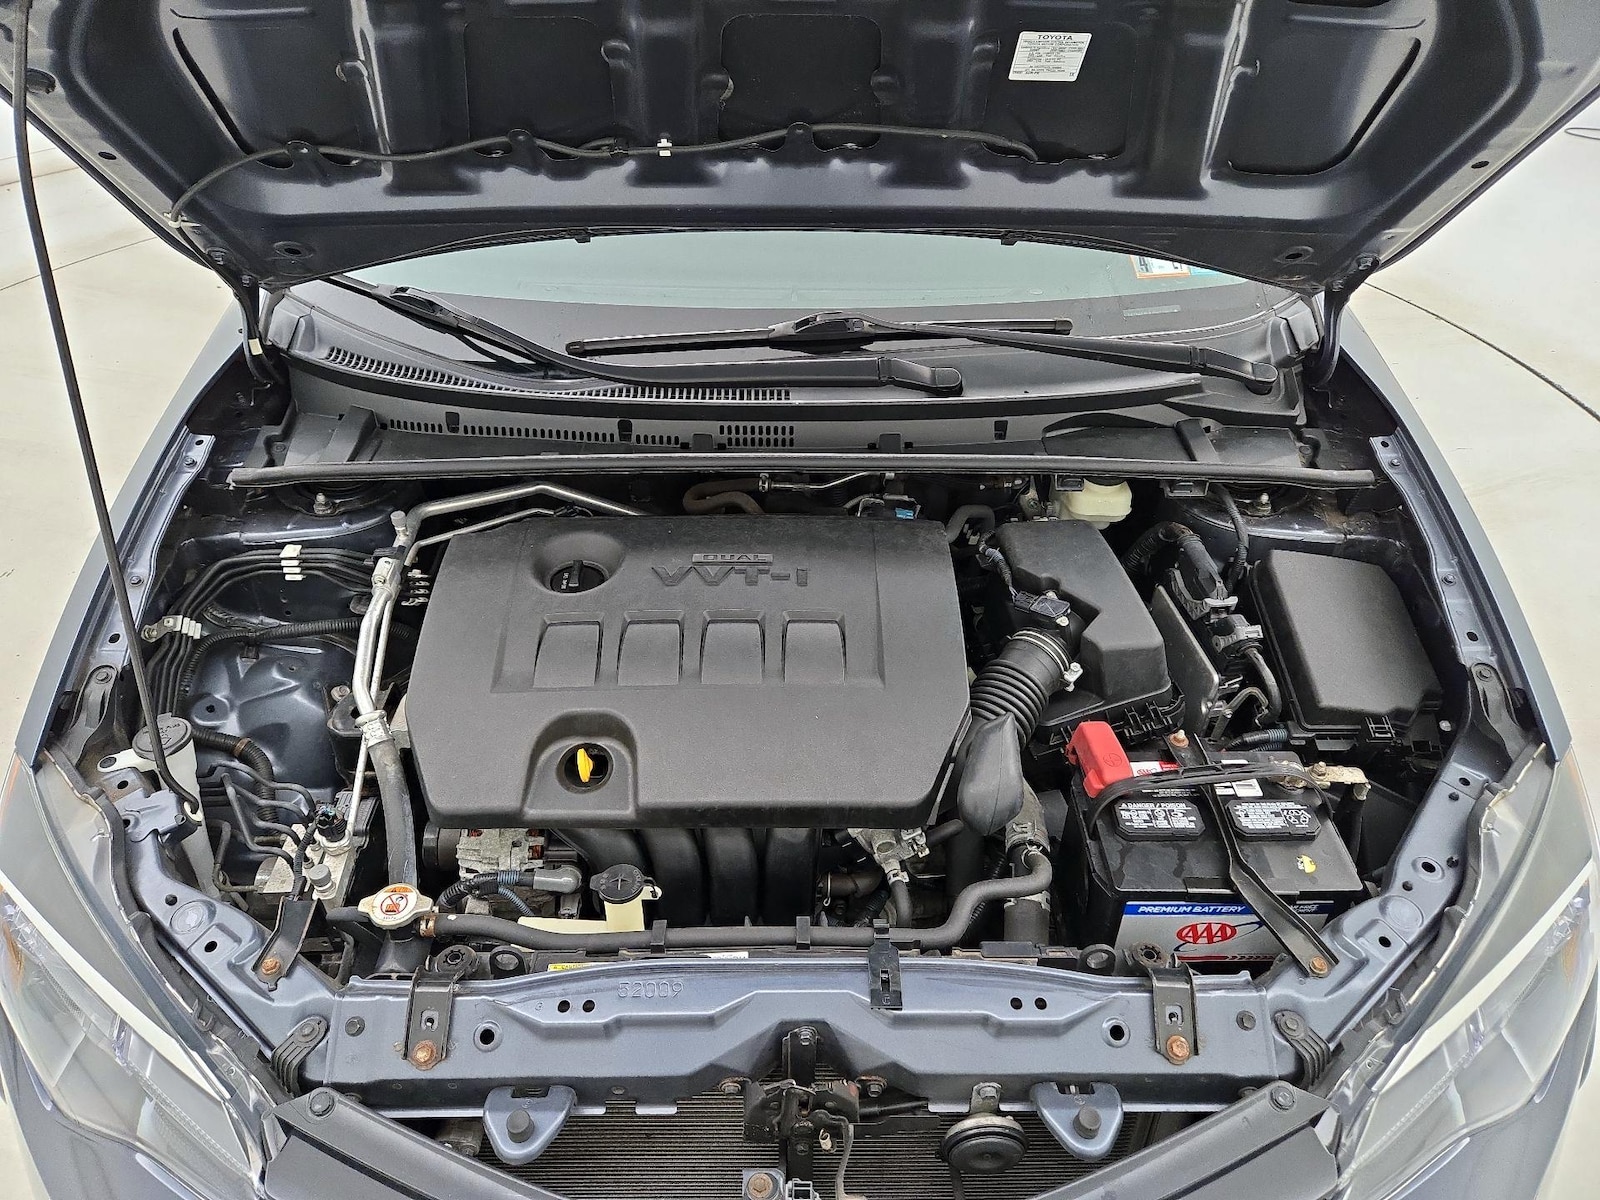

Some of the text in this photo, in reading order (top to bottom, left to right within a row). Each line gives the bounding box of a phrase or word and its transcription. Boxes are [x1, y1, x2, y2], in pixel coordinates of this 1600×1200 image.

[1137, 905, 1246, 914] PREMIUM BATTERY
[1182, 923, 1231, 944] AAA
